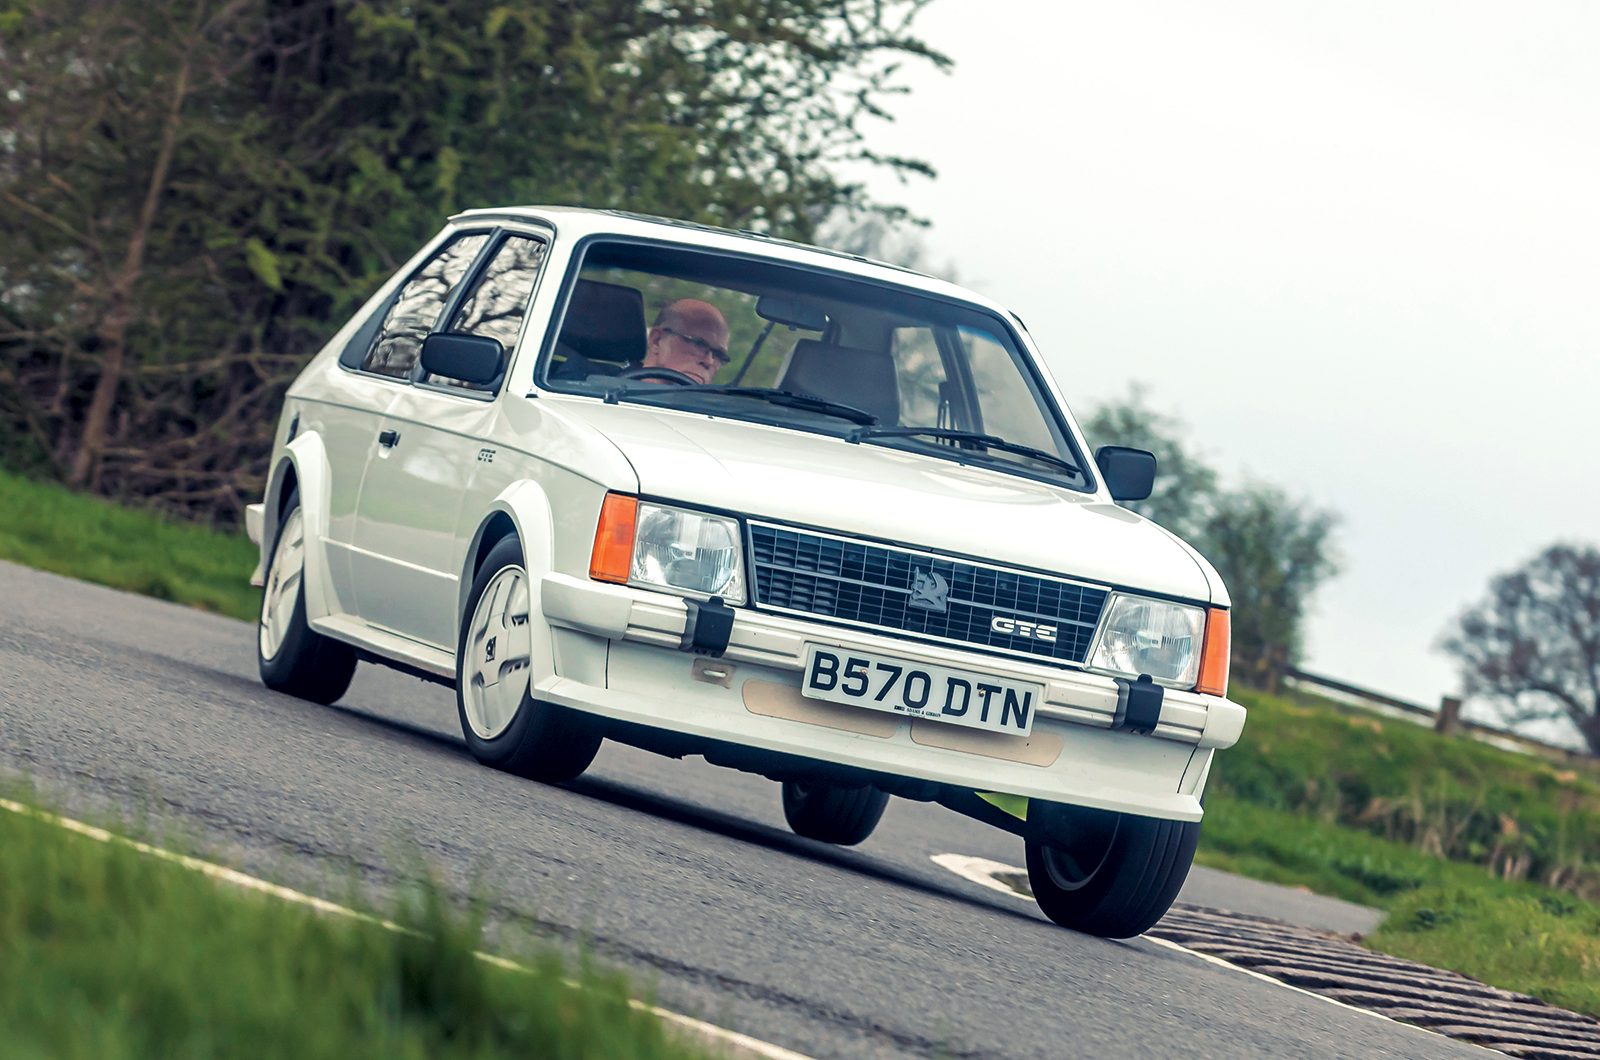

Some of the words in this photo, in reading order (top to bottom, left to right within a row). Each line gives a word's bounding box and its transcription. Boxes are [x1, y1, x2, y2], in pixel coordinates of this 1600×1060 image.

[991, 616, 1058, 643] GTE
[809, 650, 931, 709] B570
[942, 676, 1032, 729] DTN
